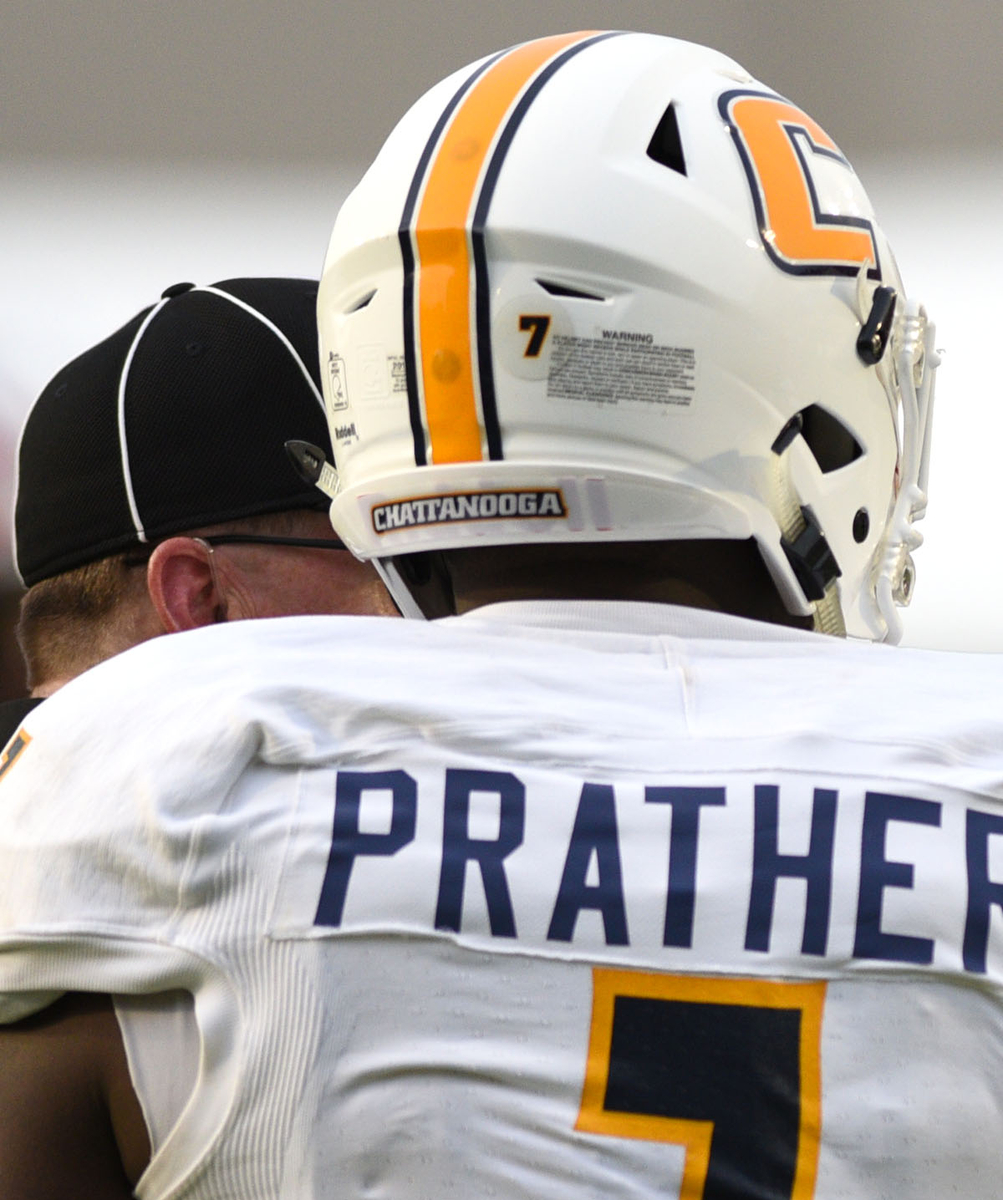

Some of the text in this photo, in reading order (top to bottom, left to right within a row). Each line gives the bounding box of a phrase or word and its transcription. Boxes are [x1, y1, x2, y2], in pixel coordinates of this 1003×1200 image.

[717, 89, 882, 281] C
[518, 314, 552, 359] 7
[602, 330, 654, 344] WARNING
[373, 491, 562, 532] CHATTANOOGA
